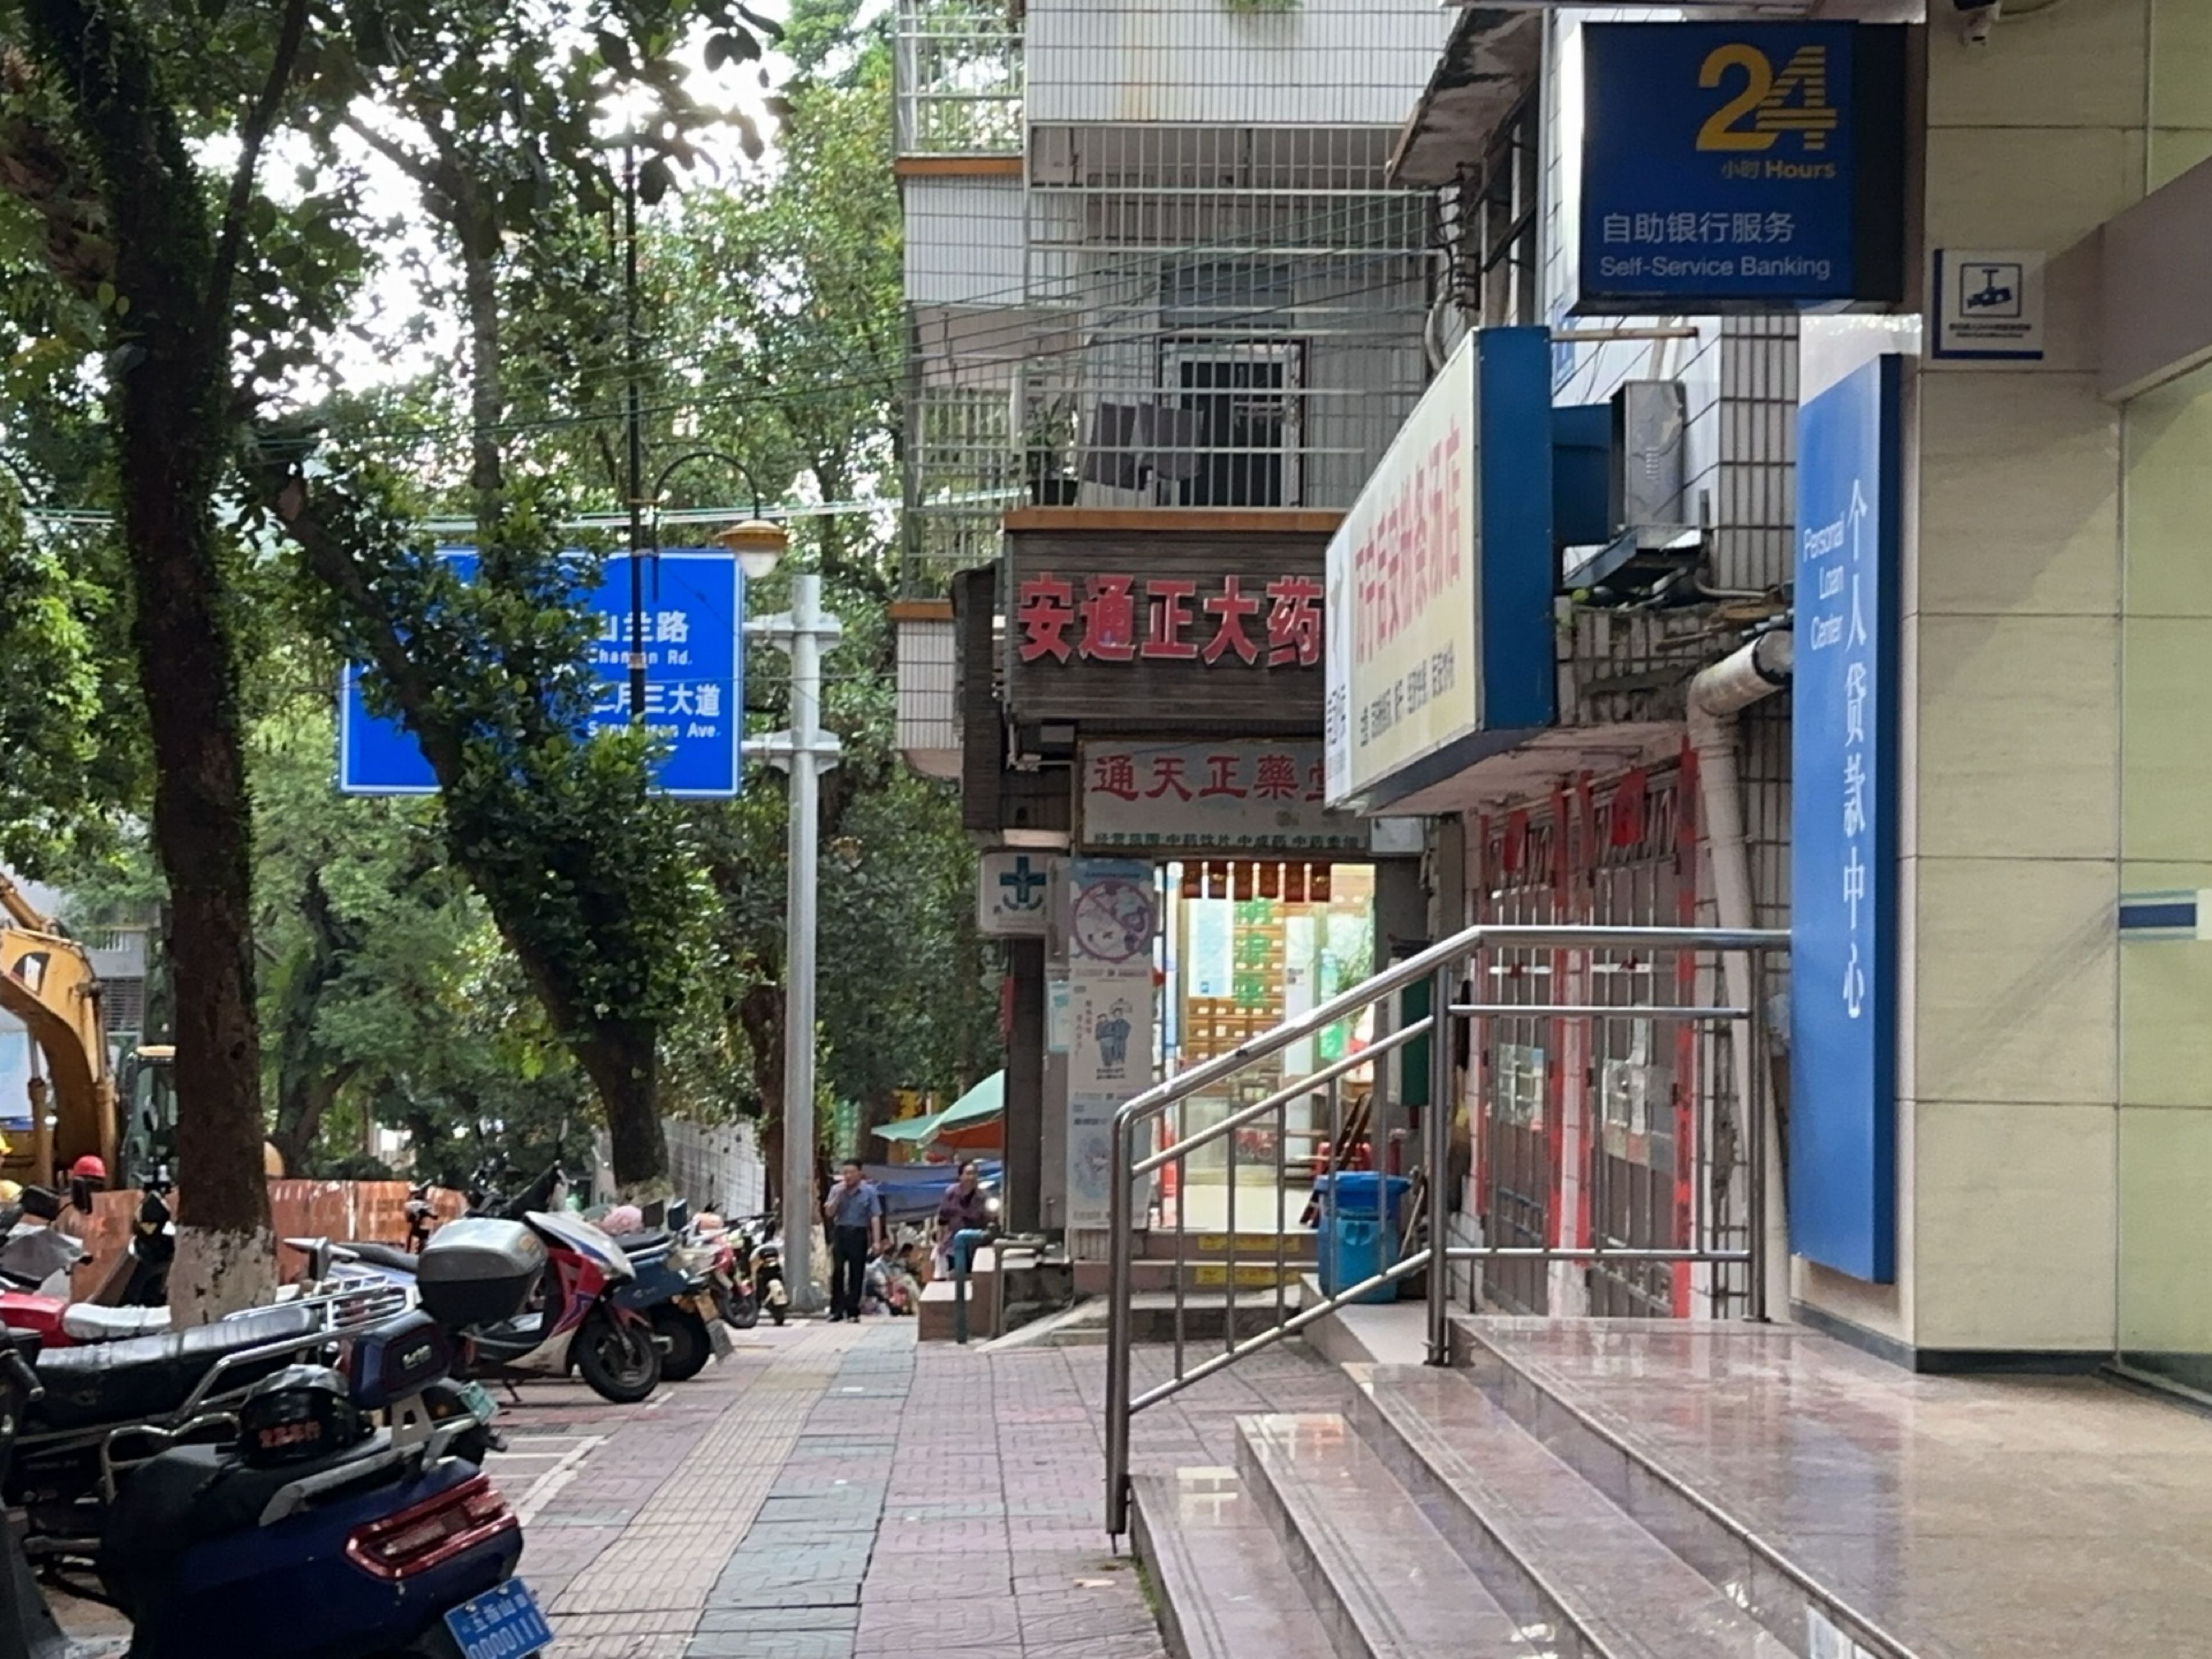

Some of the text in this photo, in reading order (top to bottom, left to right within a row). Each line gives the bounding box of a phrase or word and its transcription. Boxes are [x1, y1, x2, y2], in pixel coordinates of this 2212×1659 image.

[1695, 43, 1837, 151] 24
[1765, 160, 1836, 179] Hours
[1602, 212, 1795, 244] 自助银行服务
[1599, 255, 1831, 280] Self-Service Banking
[1803, 511, 1843, 563] Personal
[1819, 565, 1843, 600] Loan
[1018, 573, 1324, 666] 安通正大药
[1811, 612, 1843, 651] Center
[668, 649, 693, 665] Rd.
[687, 721, 721, 737] Ave.
[1843, 478, 1868, 1020] 个人贷款中心
